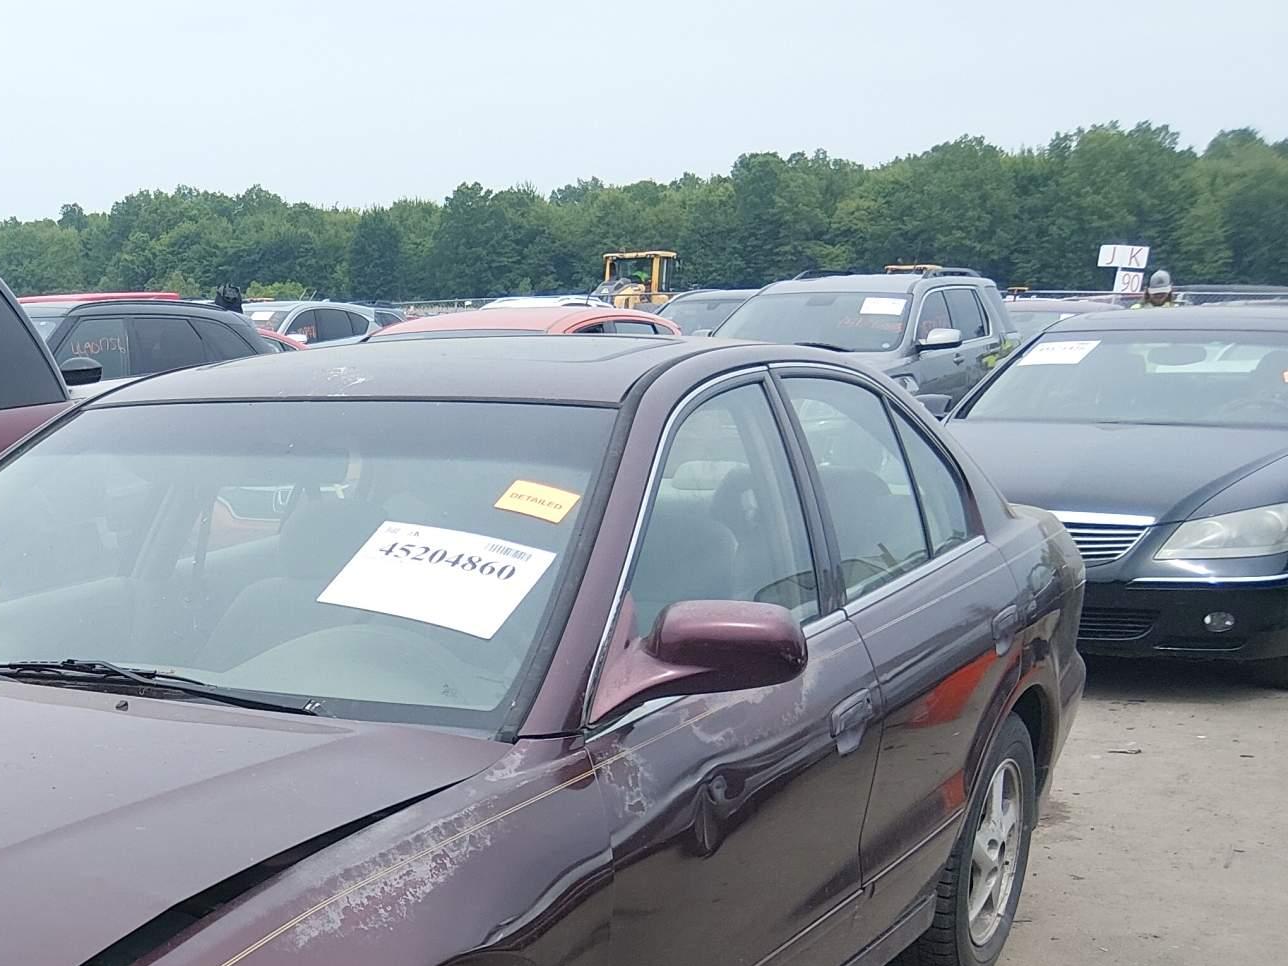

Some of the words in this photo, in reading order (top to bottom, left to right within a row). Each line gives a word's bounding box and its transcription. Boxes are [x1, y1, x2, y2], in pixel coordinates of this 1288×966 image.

[1105, 246, 1117, 266] J
[1127, 247, 1144, 267] K
[1120, 272, 1140, 293] 90
[509, 492, 563, 511] DETAILED
[379, 541, 517, 581] 45204860
